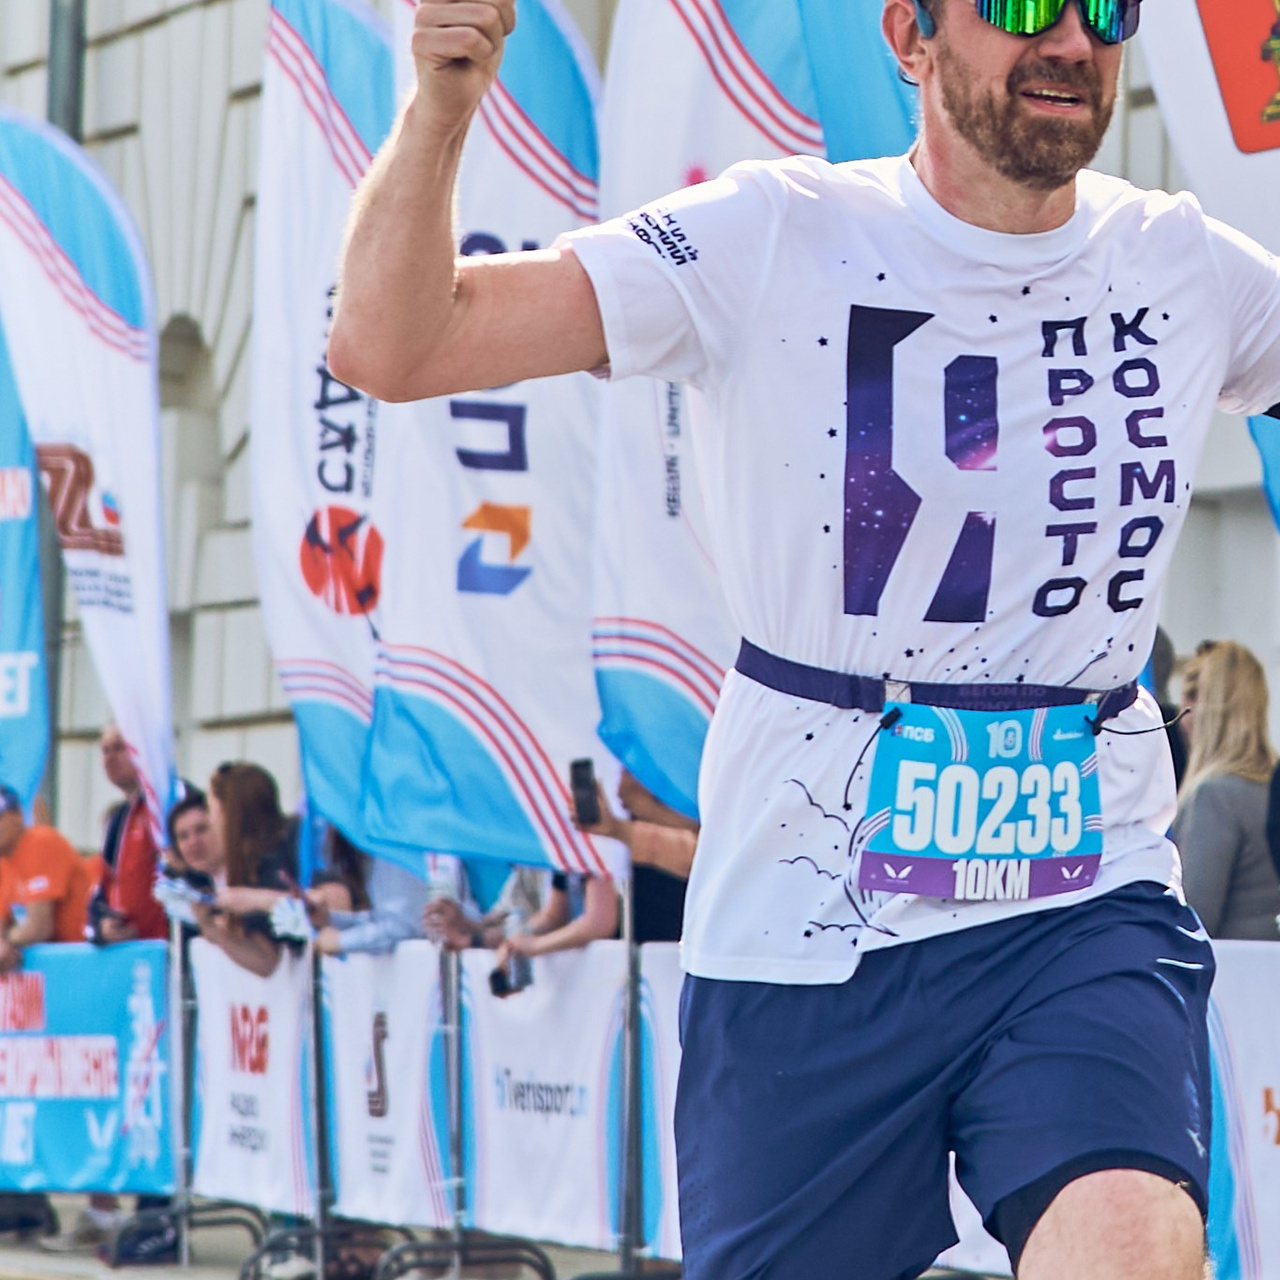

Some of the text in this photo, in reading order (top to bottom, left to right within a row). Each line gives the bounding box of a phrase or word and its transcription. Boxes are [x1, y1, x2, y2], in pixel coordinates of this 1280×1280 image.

[842, 303, 998, 624] Я
[1031, 316, 1097, 618] ПРОСТО
[1107, 306, 1176, 613] КОСМОС
[891, 758, 1083, 855] 50233
[903, 725, 935, 743] ПСБ
